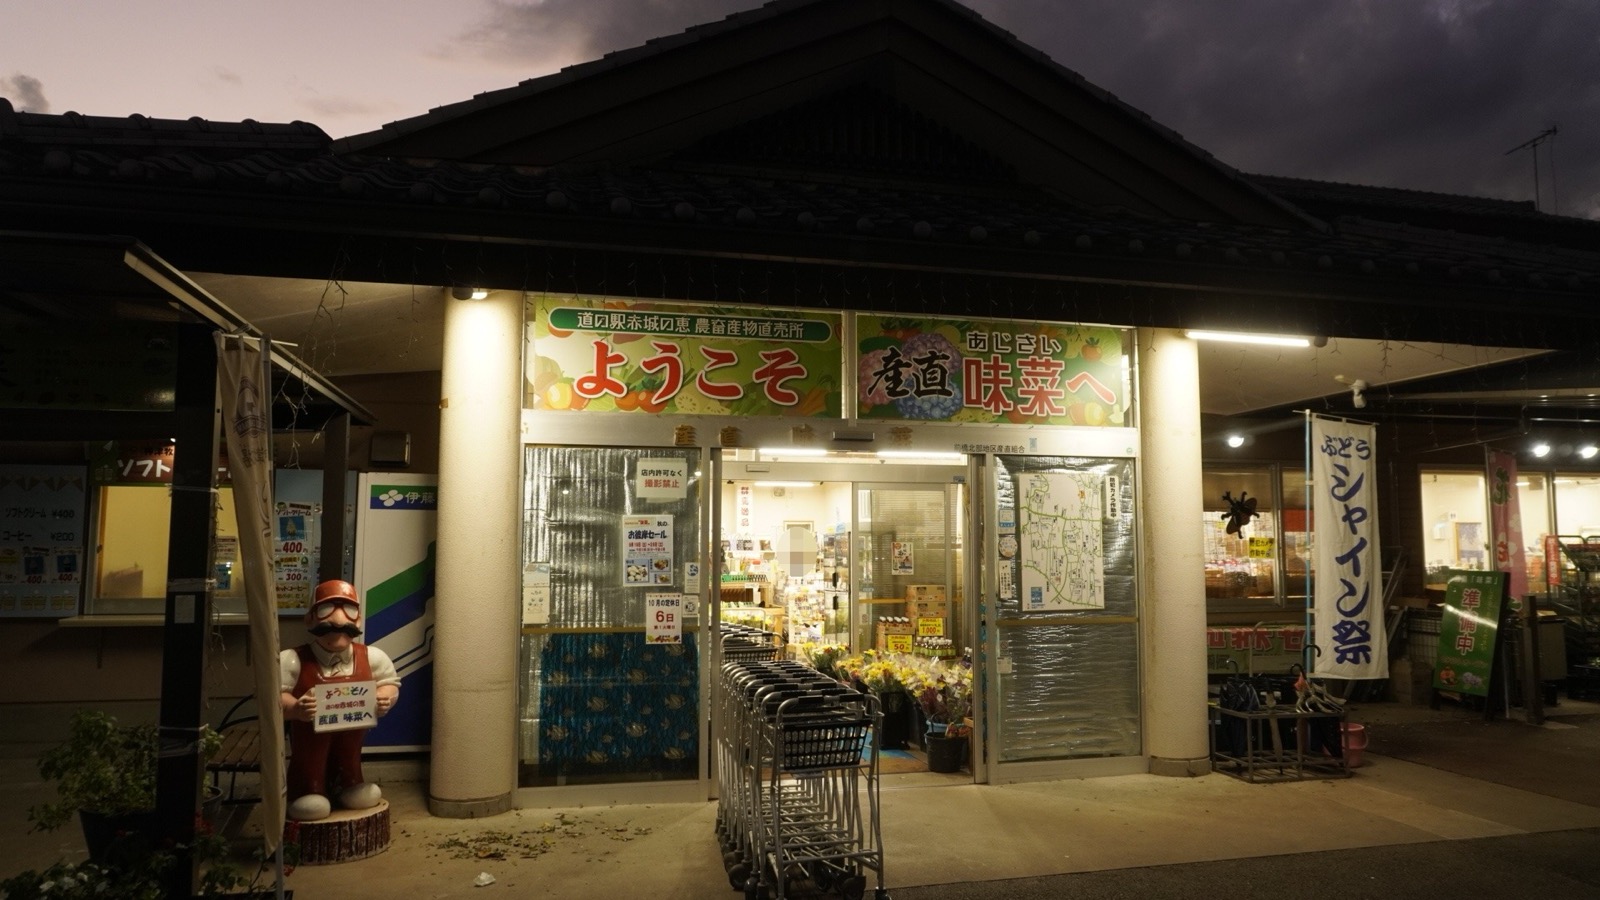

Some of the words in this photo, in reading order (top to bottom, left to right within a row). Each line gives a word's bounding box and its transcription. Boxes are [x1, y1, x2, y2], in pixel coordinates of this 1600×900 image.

[577, 311, 691, 332] 道の駅赤城の恵
[695, 317, 805, 339] 農畜産物直売所
[966, 330, 1062, 354] あじさい
[573, 339, 808, 406] ようこそ
[866, 346, 953, 399] 産直
[963, 354, 1117, 417] 味菜へ
[1321, 434, 1372, 461] ぶどう
[641, 469, 682, 477] 店内許可なく
[644, 479, 680, 488] 撮影禁止
[3, 530, 32, 541] コーヒー
[655, 610, 674, 622] 6日
